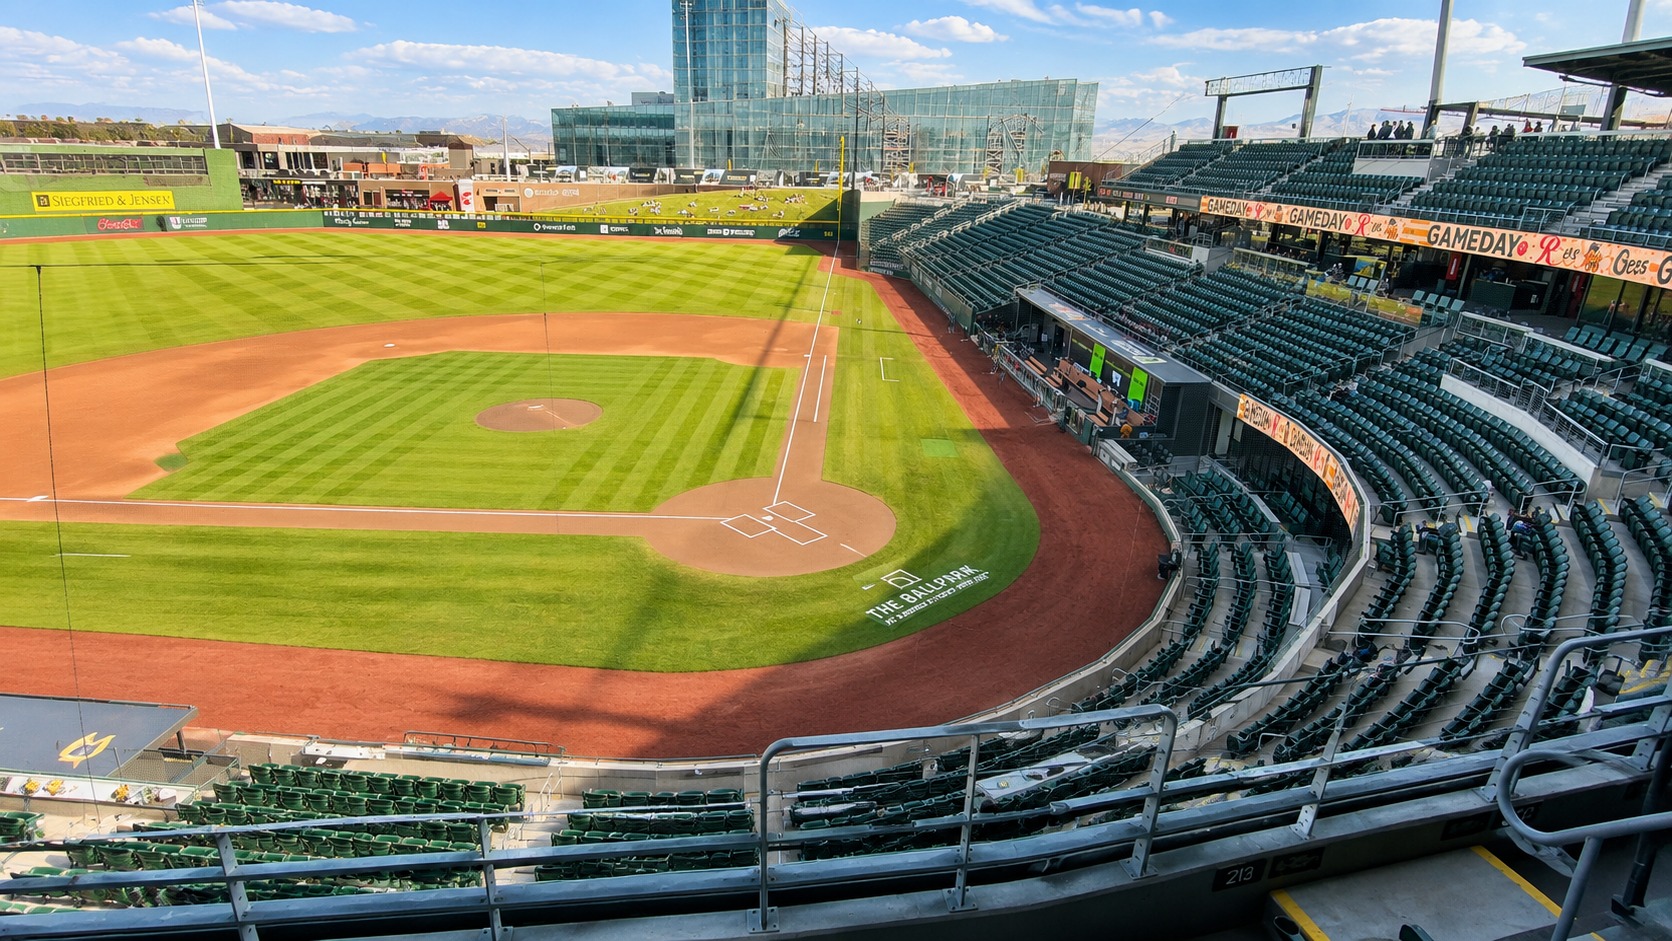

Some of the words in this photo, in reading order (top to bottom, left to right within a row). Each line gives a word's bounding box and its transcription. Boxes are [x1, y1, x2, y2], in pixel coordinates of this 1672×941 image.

[52, 194, 114, 207] SIEGFRIED
[116, 194, 127, 206] &
[1207, 198, 1248, 217] GAMEDAY
[1289, 207, 1347, 231] GAMEDAY
[1426, 224, 1522, 258] GAMEDAY
[865, 599, 904, 619] THE
[899, 564, 980, 603] BALLPARK
[1225, 866, 1254, 885] 213
